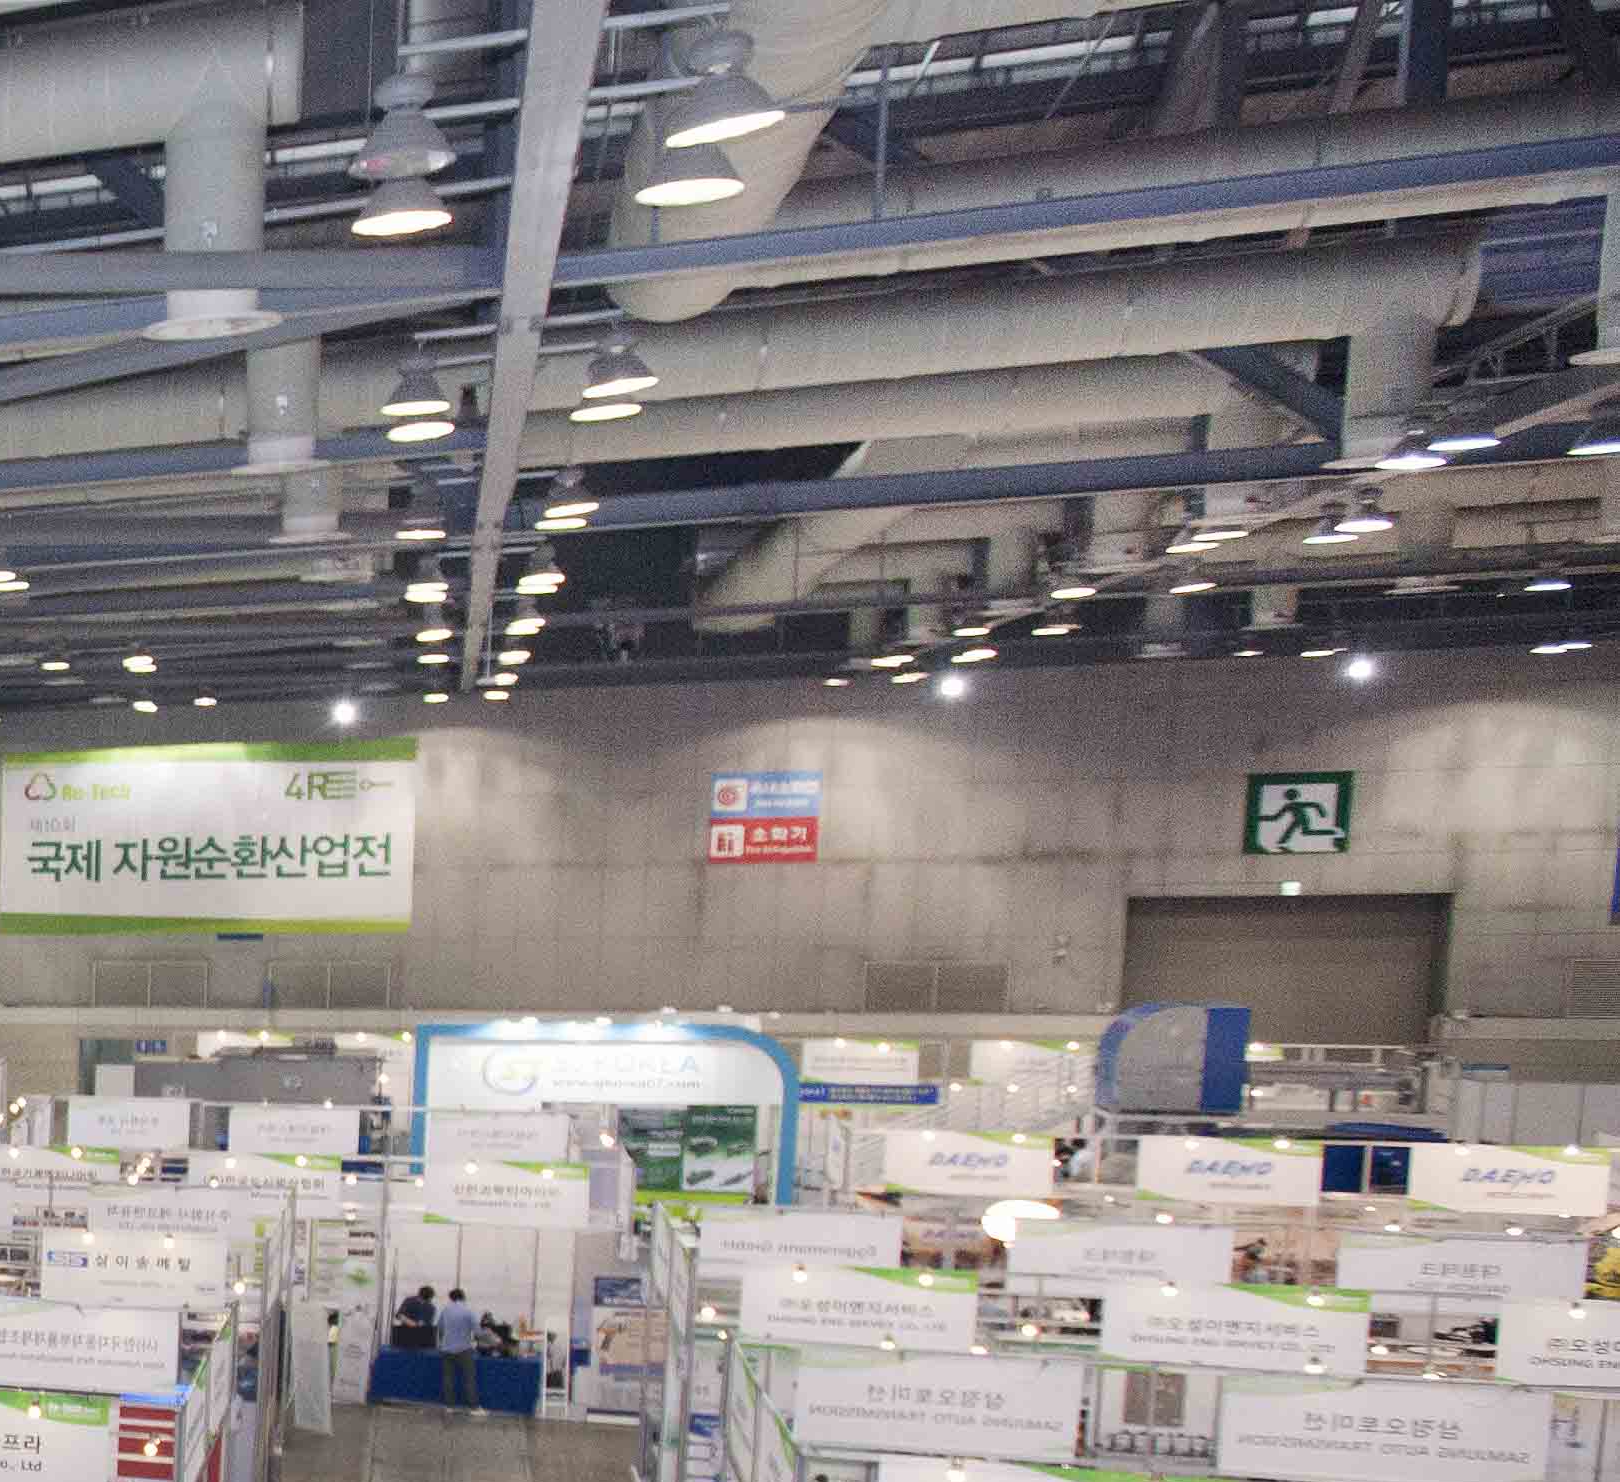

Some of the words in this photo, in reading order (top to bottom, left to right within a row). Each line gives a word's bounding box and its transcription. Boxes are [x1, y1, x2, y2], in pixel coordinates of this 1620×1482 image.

[26, 837, 101, 882] 국제
[112, 831, 392, 882] 자원순환산업전
[18, 1456, 43, 1472] Ltd
